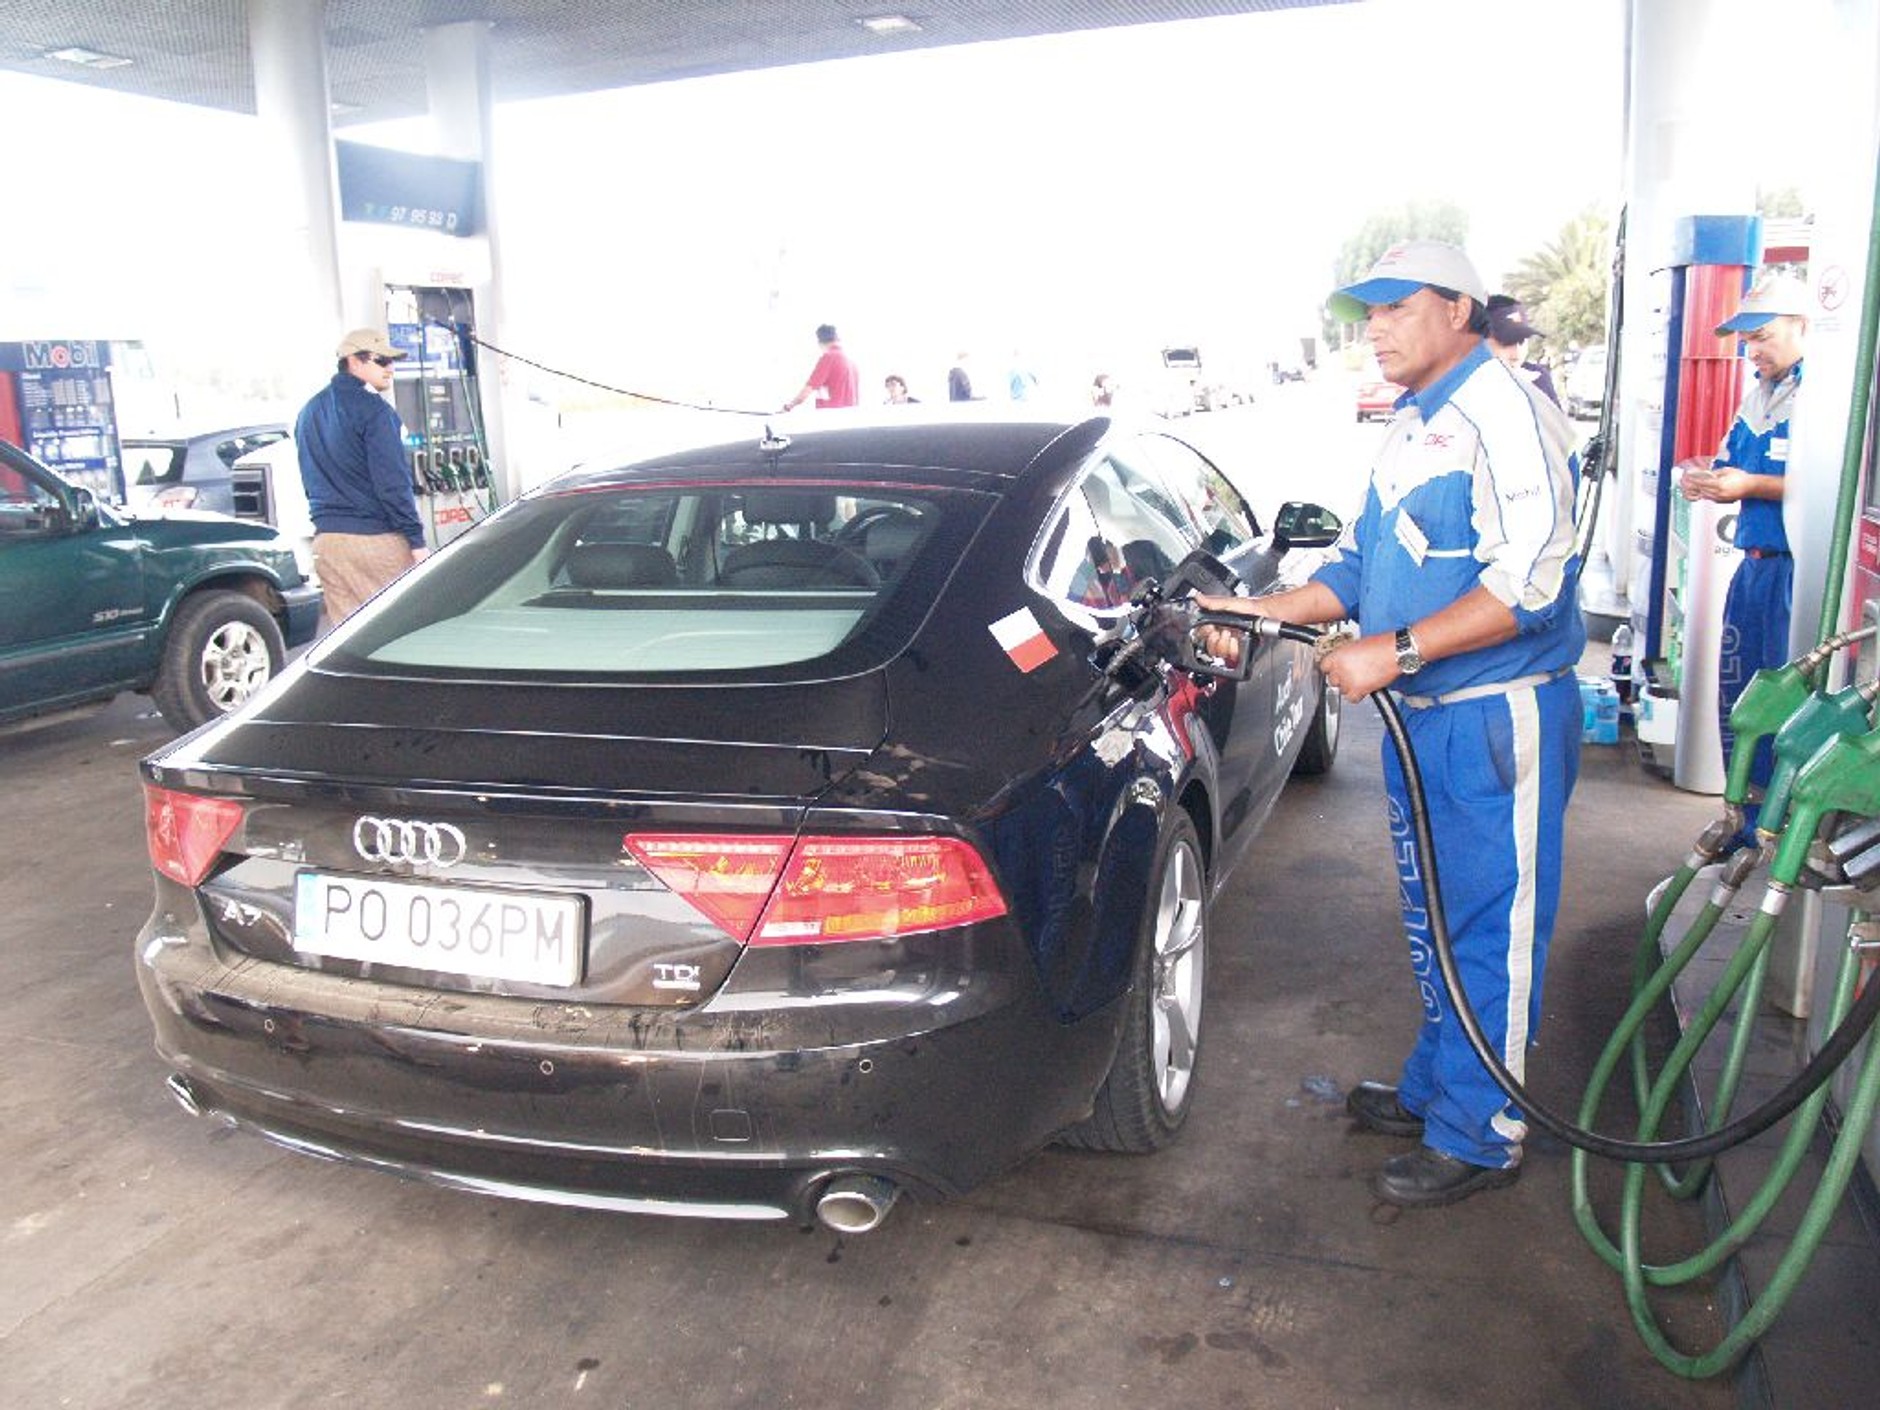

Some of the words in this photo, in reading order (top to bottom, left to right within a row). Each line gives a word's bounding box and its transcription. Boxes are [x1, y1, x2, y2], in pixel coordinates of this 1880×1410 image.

[221, 899, 262, 926] A7
[325, 884, 387, 941] PO
[408, 895, 564, 964] 036PM
[653, 963, 701, 981] TDI
